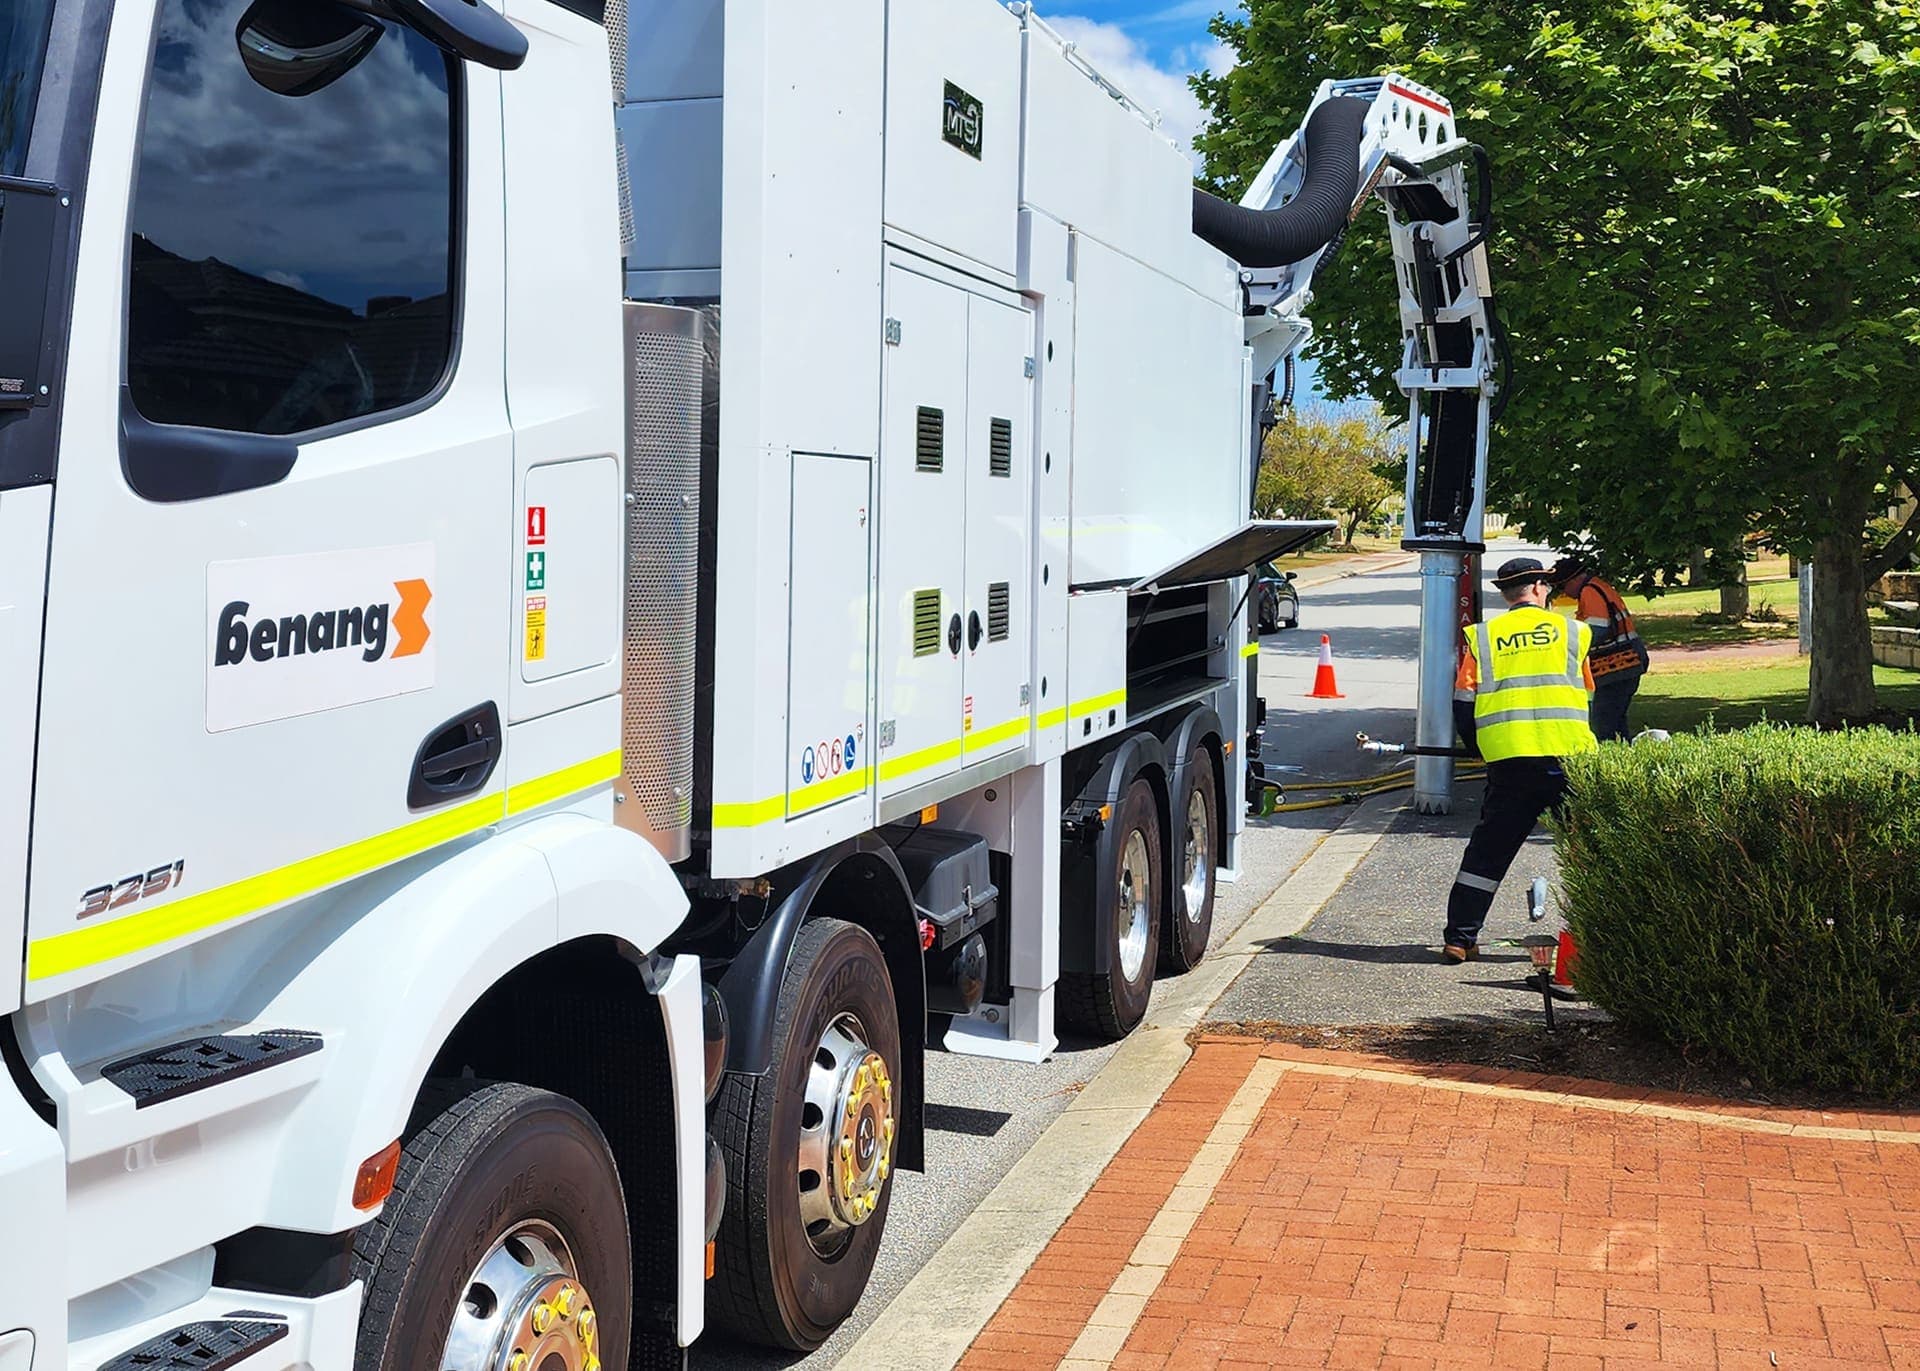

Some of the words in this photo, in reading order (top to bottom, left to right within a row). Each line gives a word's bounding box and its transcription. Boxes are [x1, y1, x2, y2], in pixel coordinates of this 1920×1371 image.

[946, 104, 975, 145] MTS
[214, 600, 389, 667] benang
[1496, 630, 1551, 651] MTS
[76, 859, 185, 921] 3251
